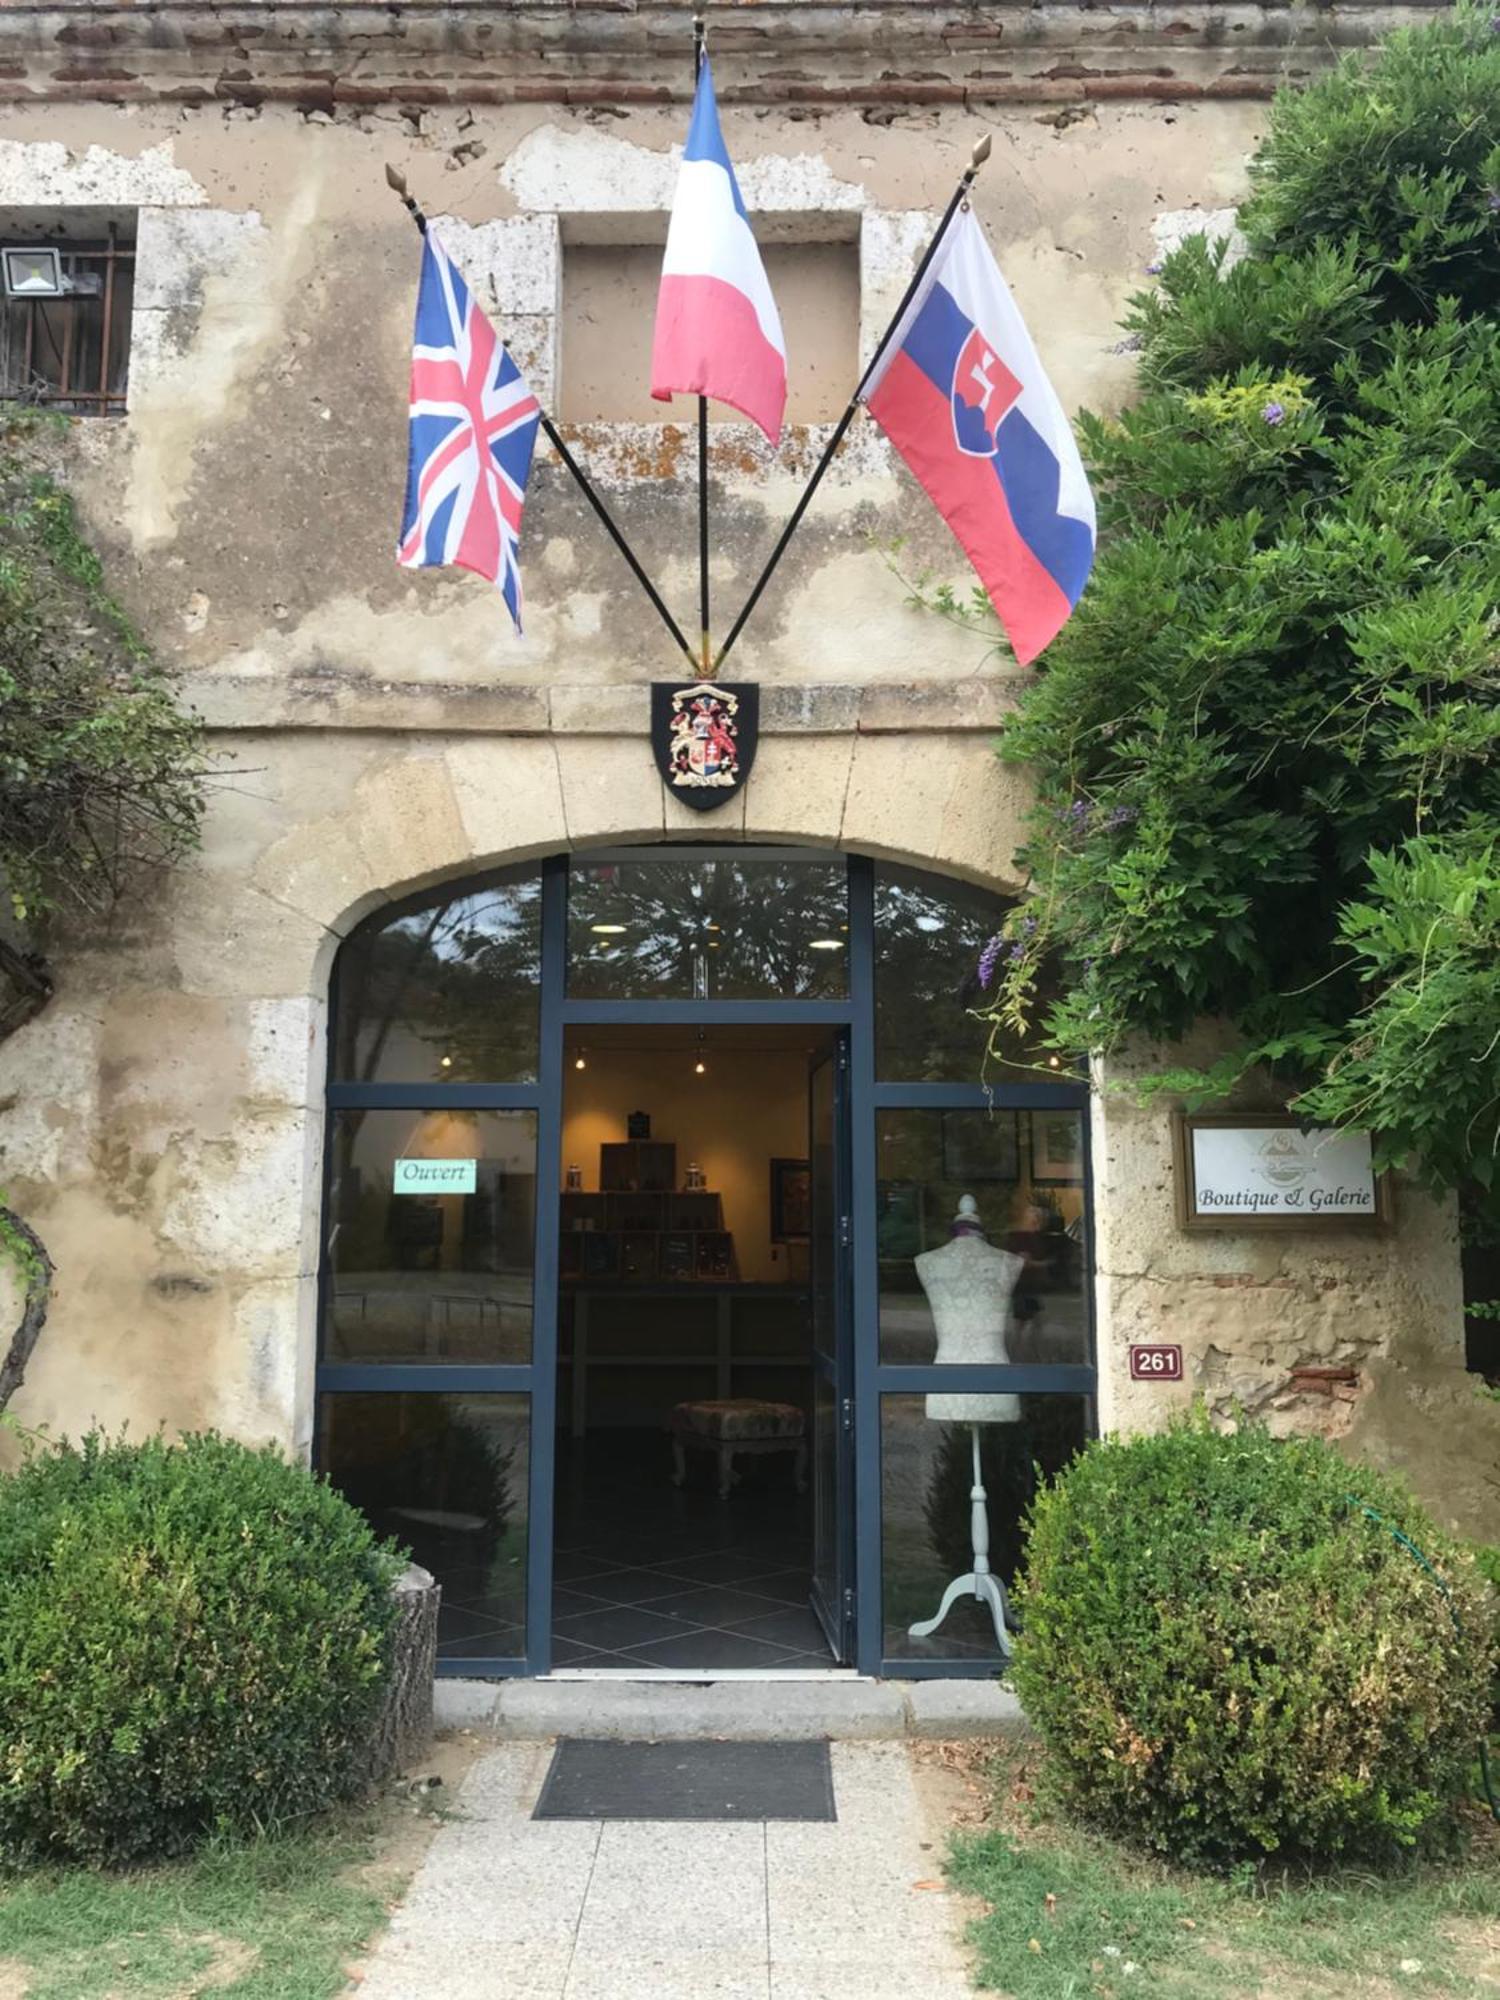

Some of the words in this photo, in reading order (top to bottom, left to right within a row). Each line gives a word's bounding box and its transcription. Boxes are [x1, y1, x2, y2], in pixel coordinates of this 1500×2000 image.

[403, 1163, 465, 1181] Ouvert
[1199, 1188, 1278, 1211] Boutique
[1284, 1186, 1304, 1207] &
[1309, 1186, 1370, 1211] Galerie
[1139, 1352, 1174, 1371] 261
